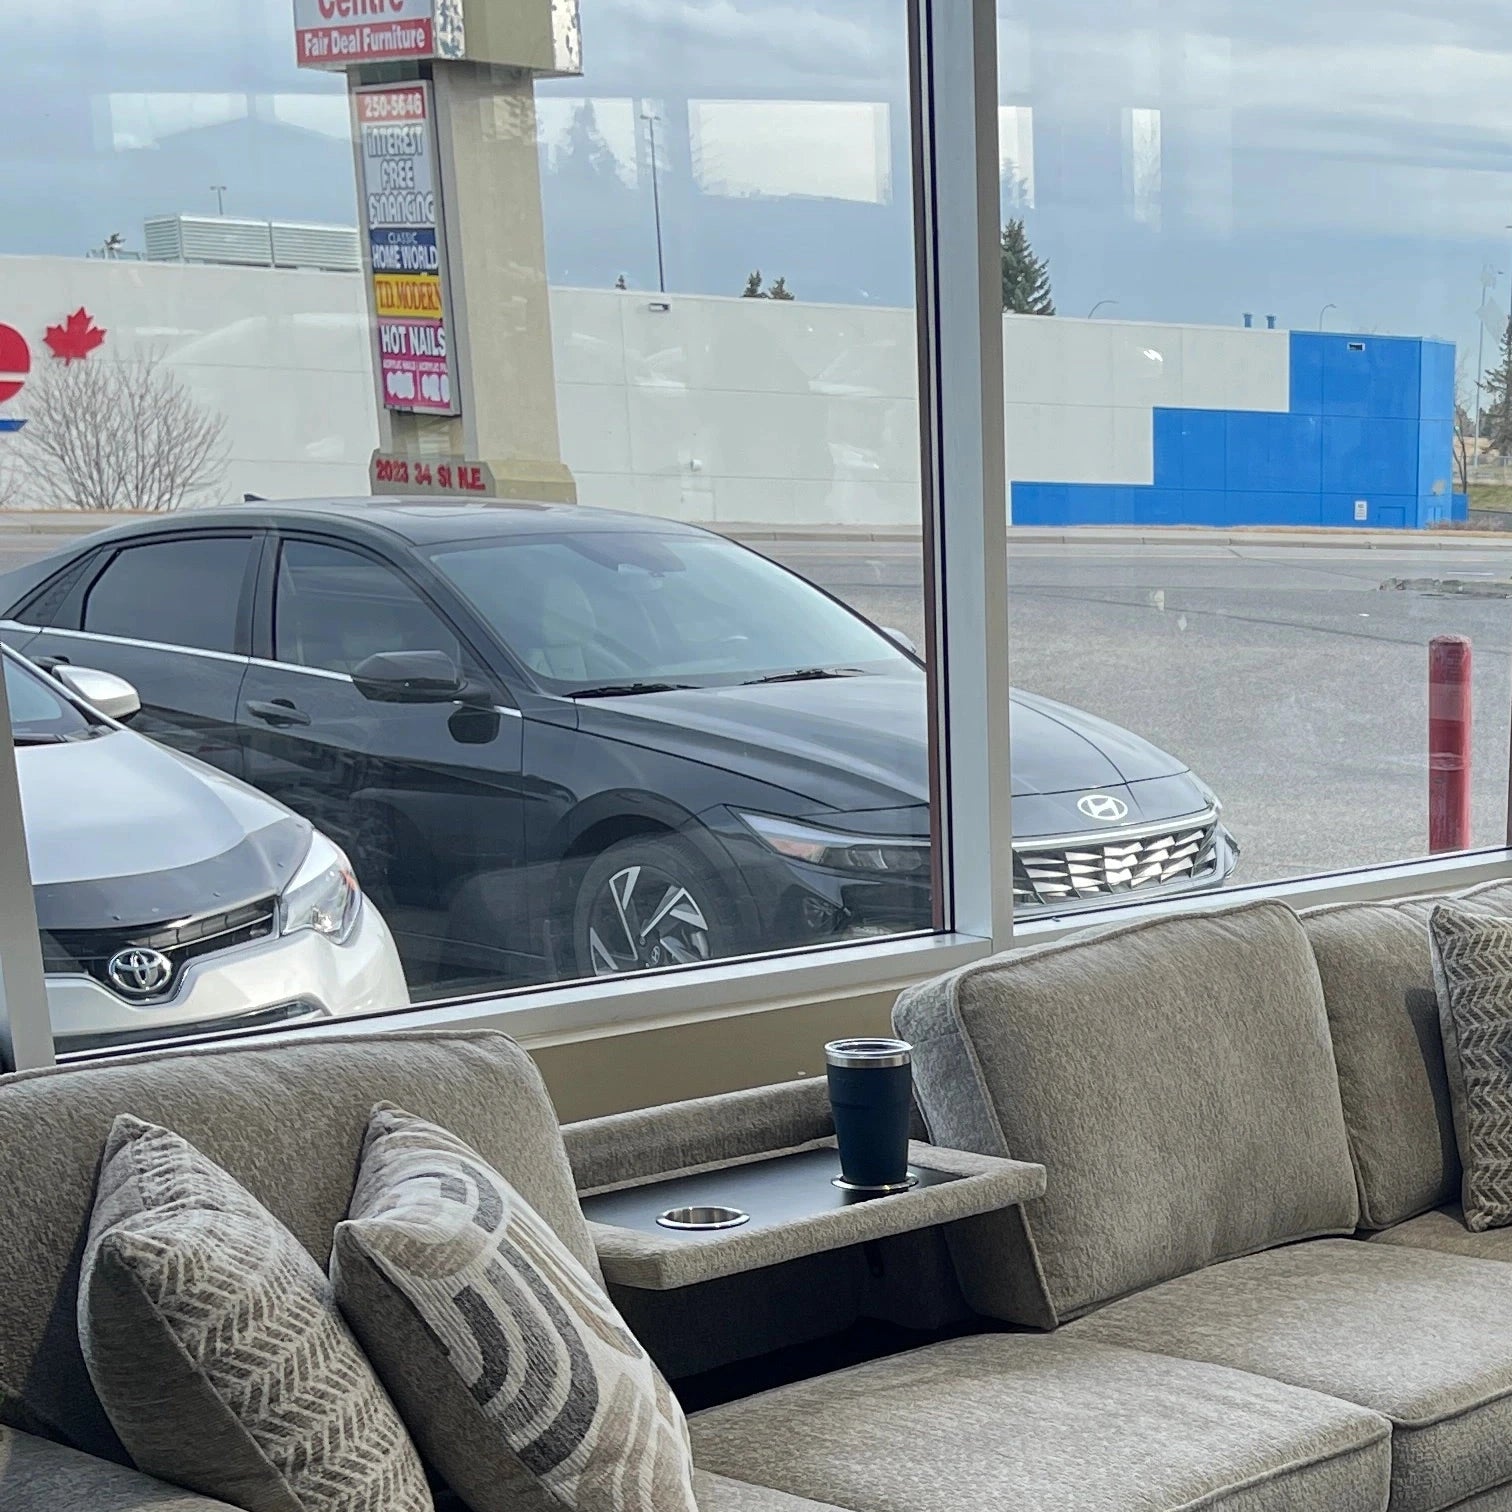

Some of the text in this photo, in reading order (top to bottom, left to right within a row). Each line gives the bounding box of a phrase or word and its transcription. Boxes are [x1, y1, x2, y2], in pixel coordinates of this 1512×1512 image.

[304, 25, 425, 56] Fair Deal Furniture
[364, 93, 422, 118] 250-5646
[381, 158, 415, 190] FREE
[372, 245, 438, 269] HOME WORLD
[381, 325, 446, 357] HOT NAILS
[375, 459, 409, 483] 2023
[414, 462, 432, 486] 34
